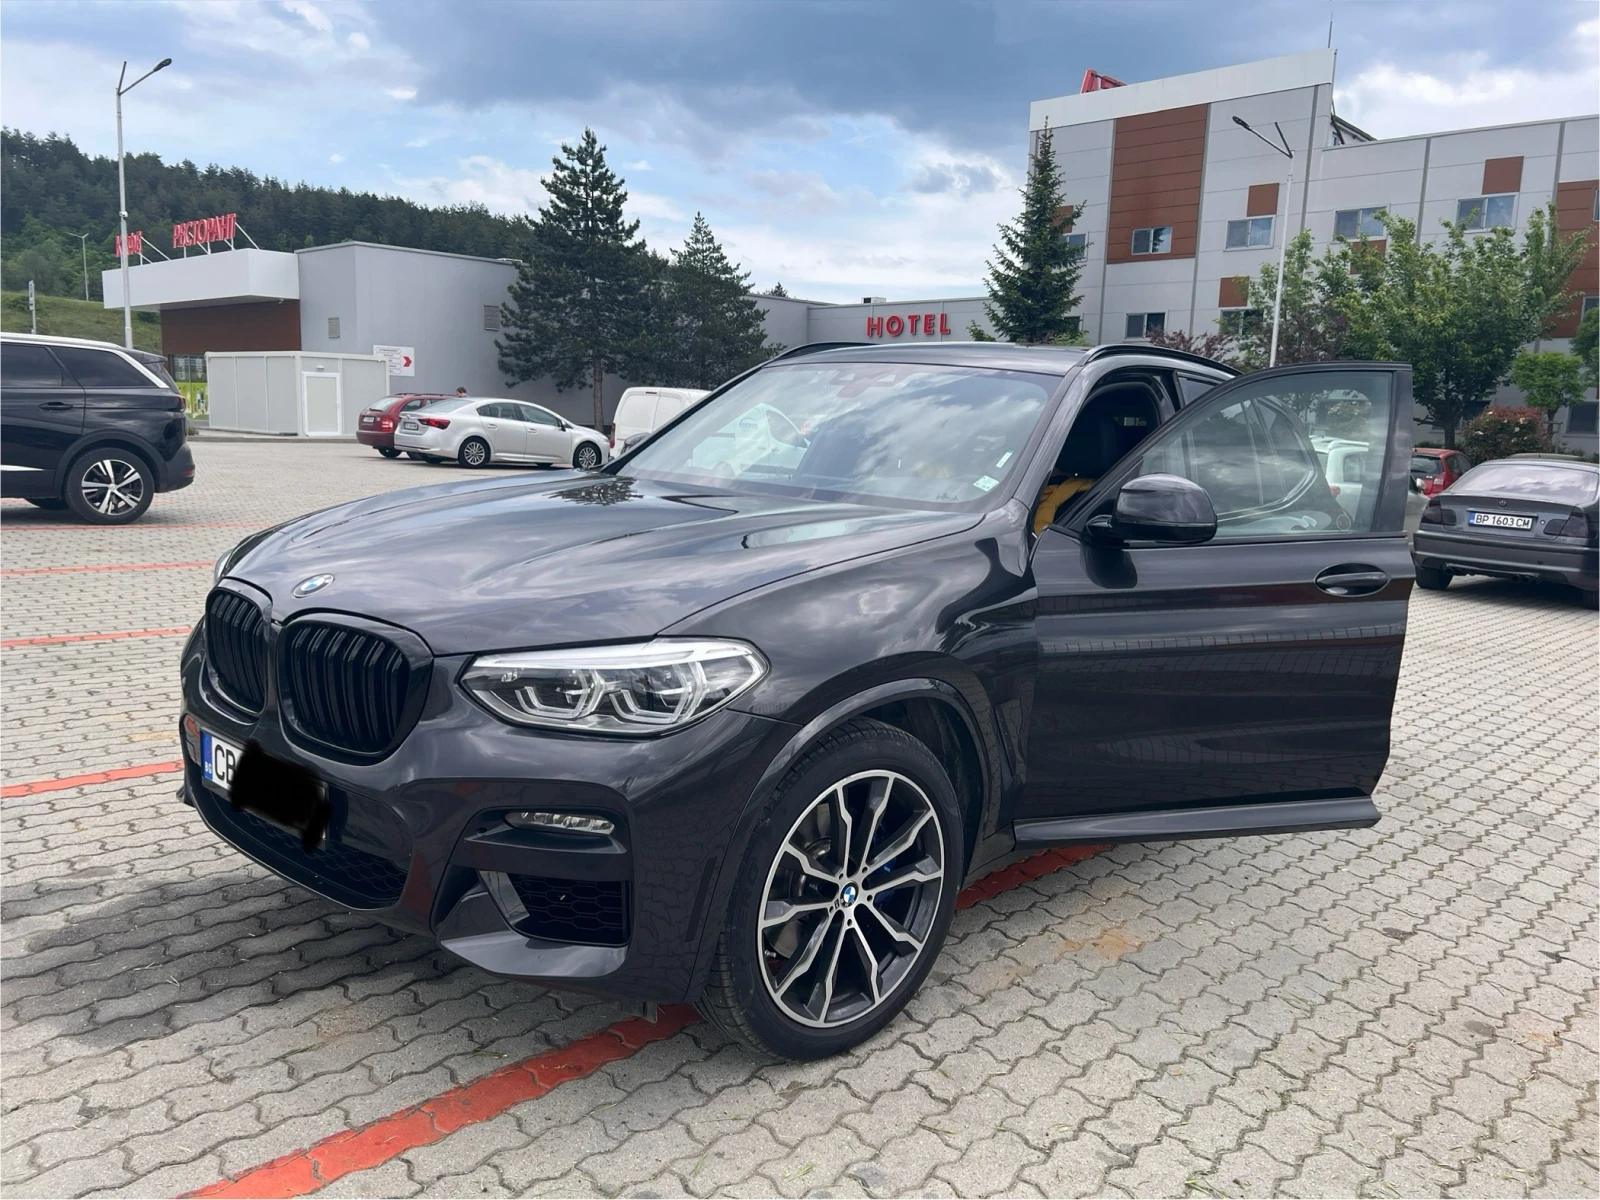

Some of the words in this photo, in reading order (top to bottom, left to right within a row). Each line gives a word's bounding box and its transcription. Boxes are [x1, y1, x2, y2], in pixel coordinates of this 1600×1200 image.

[173, 213, 236, 248] РЕСТОРАНТ
[866, 313, 950, 337] HOTEL
[1492, 516, 1514, 527] 1603
